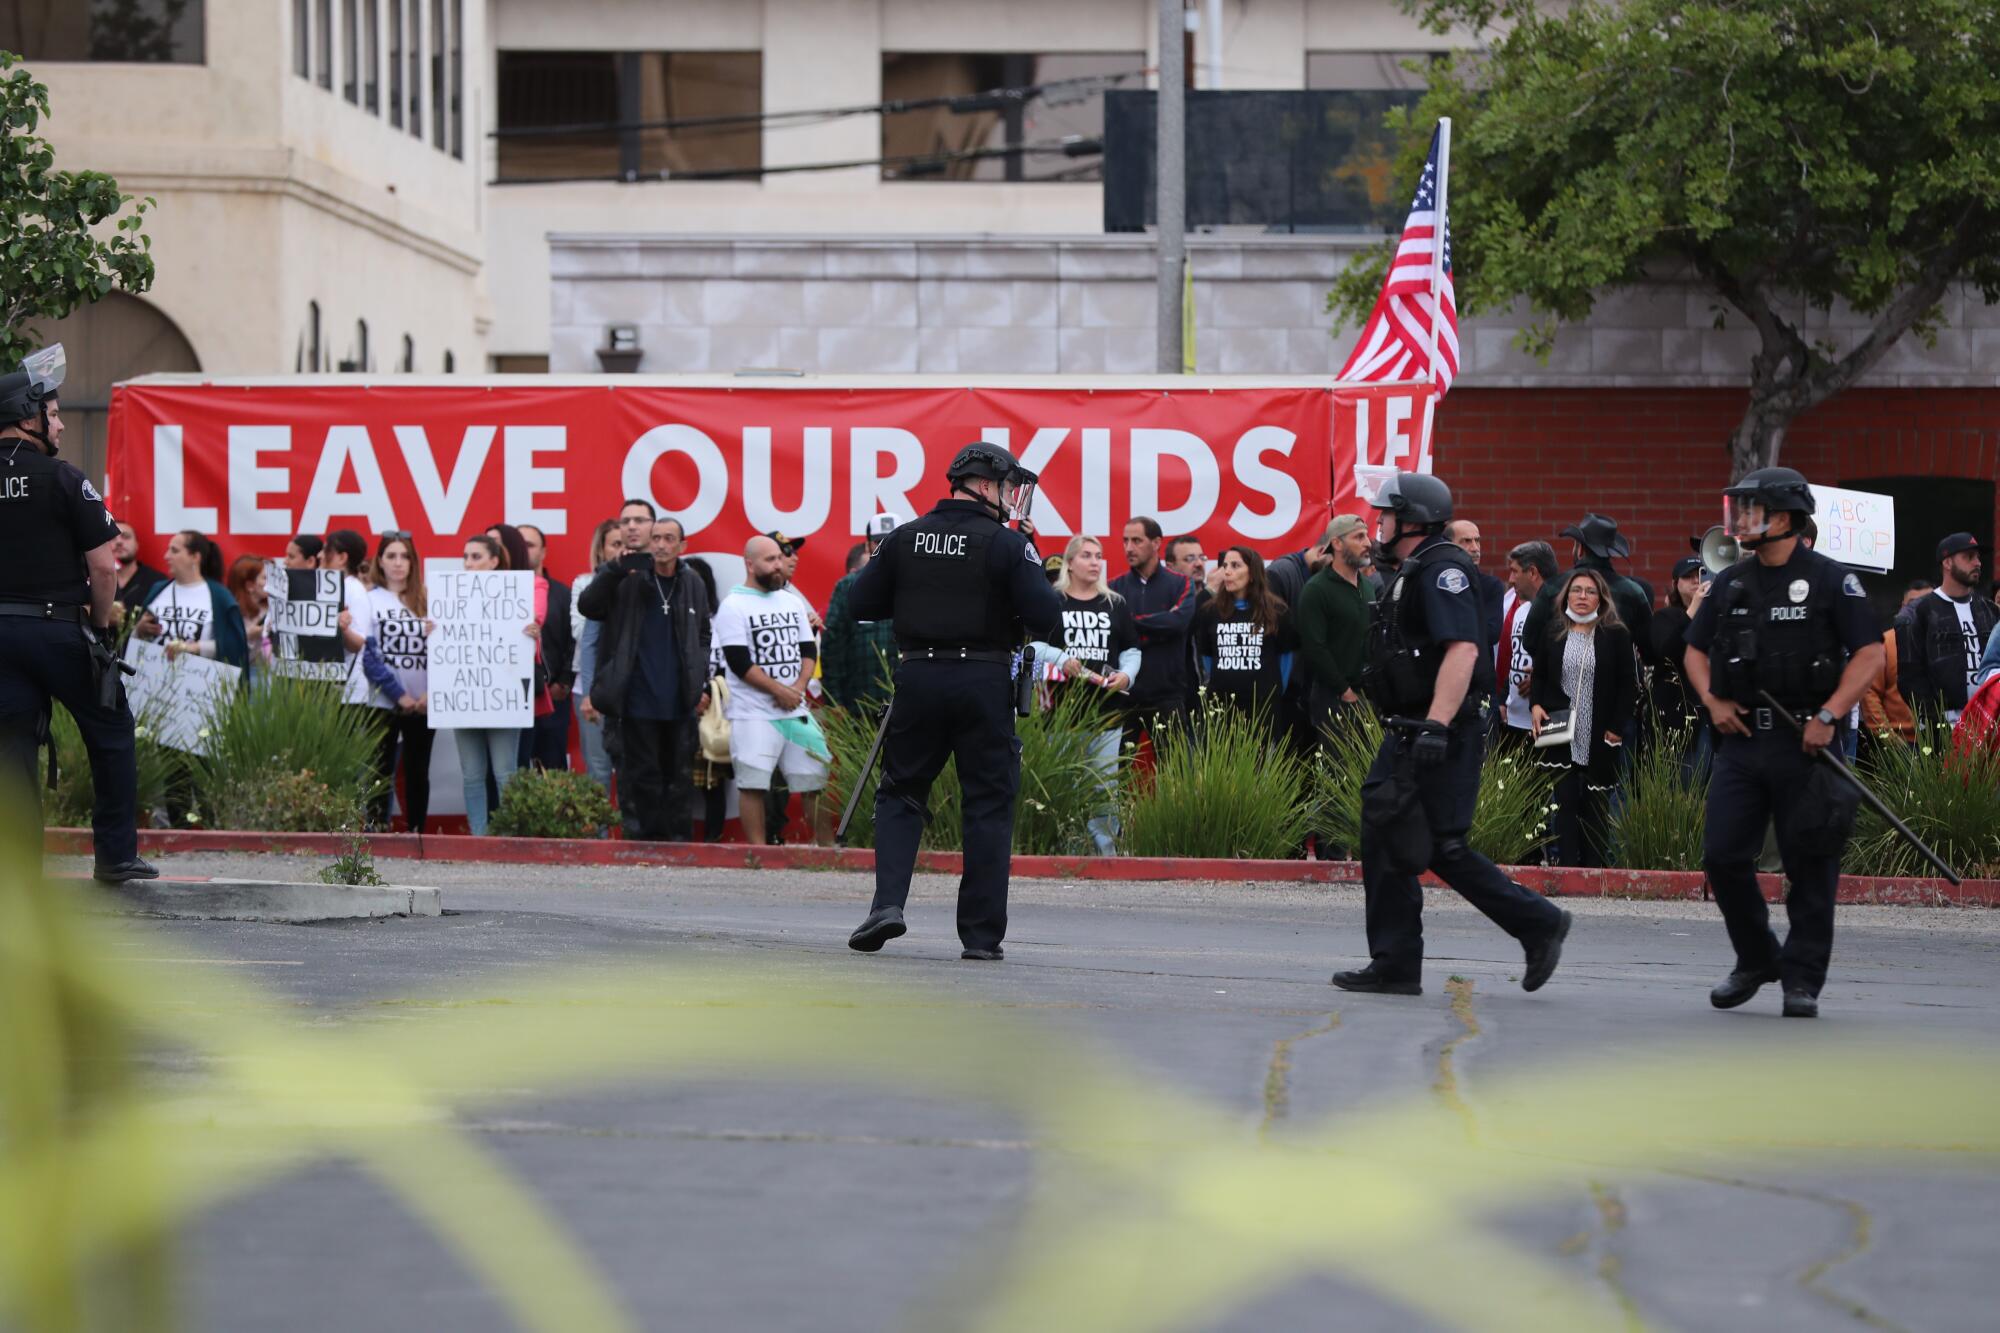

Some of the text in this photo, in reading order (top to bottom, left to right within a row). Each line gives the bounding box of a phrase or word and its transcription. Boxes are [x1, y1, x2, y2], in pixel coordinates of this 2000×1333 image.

[153, 423, 1301, 540] LEAVE OUR KIDS
[914, 532, 967, 556] POLICE
[317, 569, 337, 595] IS
[439, 573, 517, 599] TEACH
[276, 601, 337, 629] PRIDE
[377, 608, 412, 619] LEA
[431, 599, 529, 620] OUR KIDS
[1062, 610, 1111, 629] KIDS
[1771, 606, 1807, 620] POLICE
[749, 612, 800, 629] LEAVE
[281, 633, 297, 659] IN
[382, 636, 428, 653] KID
[757, 627, 800, 648] OUR
[1064, 628, 1111, 648] CANT
[1217, 633, 1263, 646] ARE THE
[434, 644, 519, 665] SCIENCE
[758, 644, 801, 664] KIDS
[1217, 646, 1262, 658] TRUSTED
[384, 656, 428, 671] LON
[761, 665, 800, 679] LON
[1217, 657, 1262, 670] ADULTS
[454, 667, 493, 688] AND
[432, 677, 531, 713] ENGLISH!
